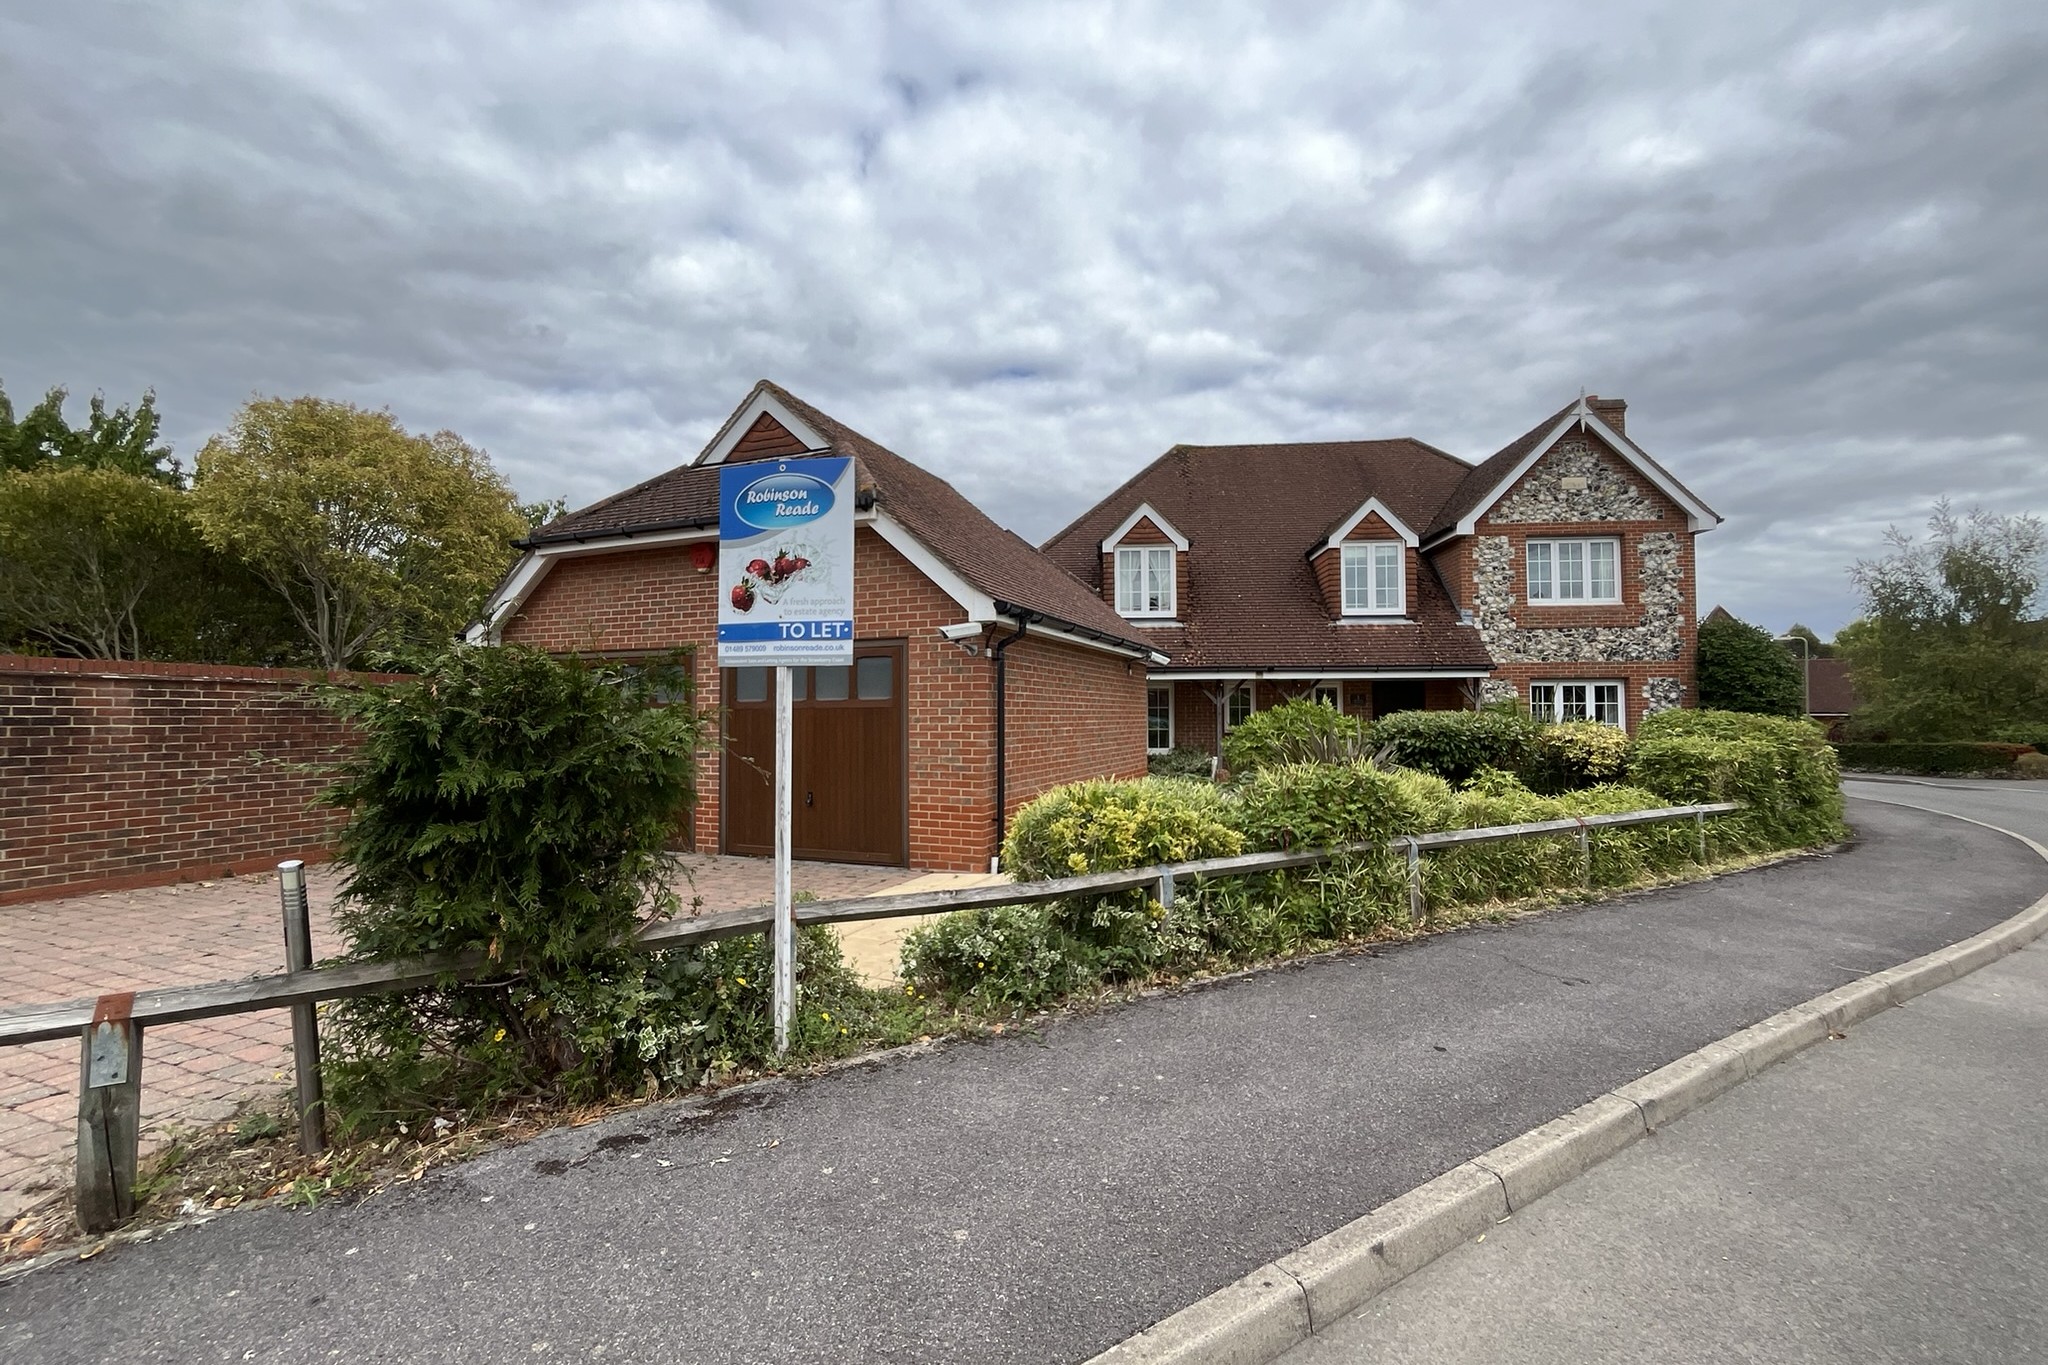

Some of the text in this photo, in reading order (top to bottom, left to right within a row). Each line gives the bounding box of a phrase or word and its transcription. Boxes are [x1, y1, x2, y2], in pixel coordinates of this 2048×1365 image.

[746, 488, 807, 503] Robinson
[775, 501, 819, 516] Reade
[790, 597, 809, 606] fresh
[810, 595, 846, 607] approach
[793, 608, 818, 616] estate
[818, 607, 845, 618] agency
[778, 622, 845, 639] TO LET
[773, 644, 845, 652] robinsonreade.co.uk
